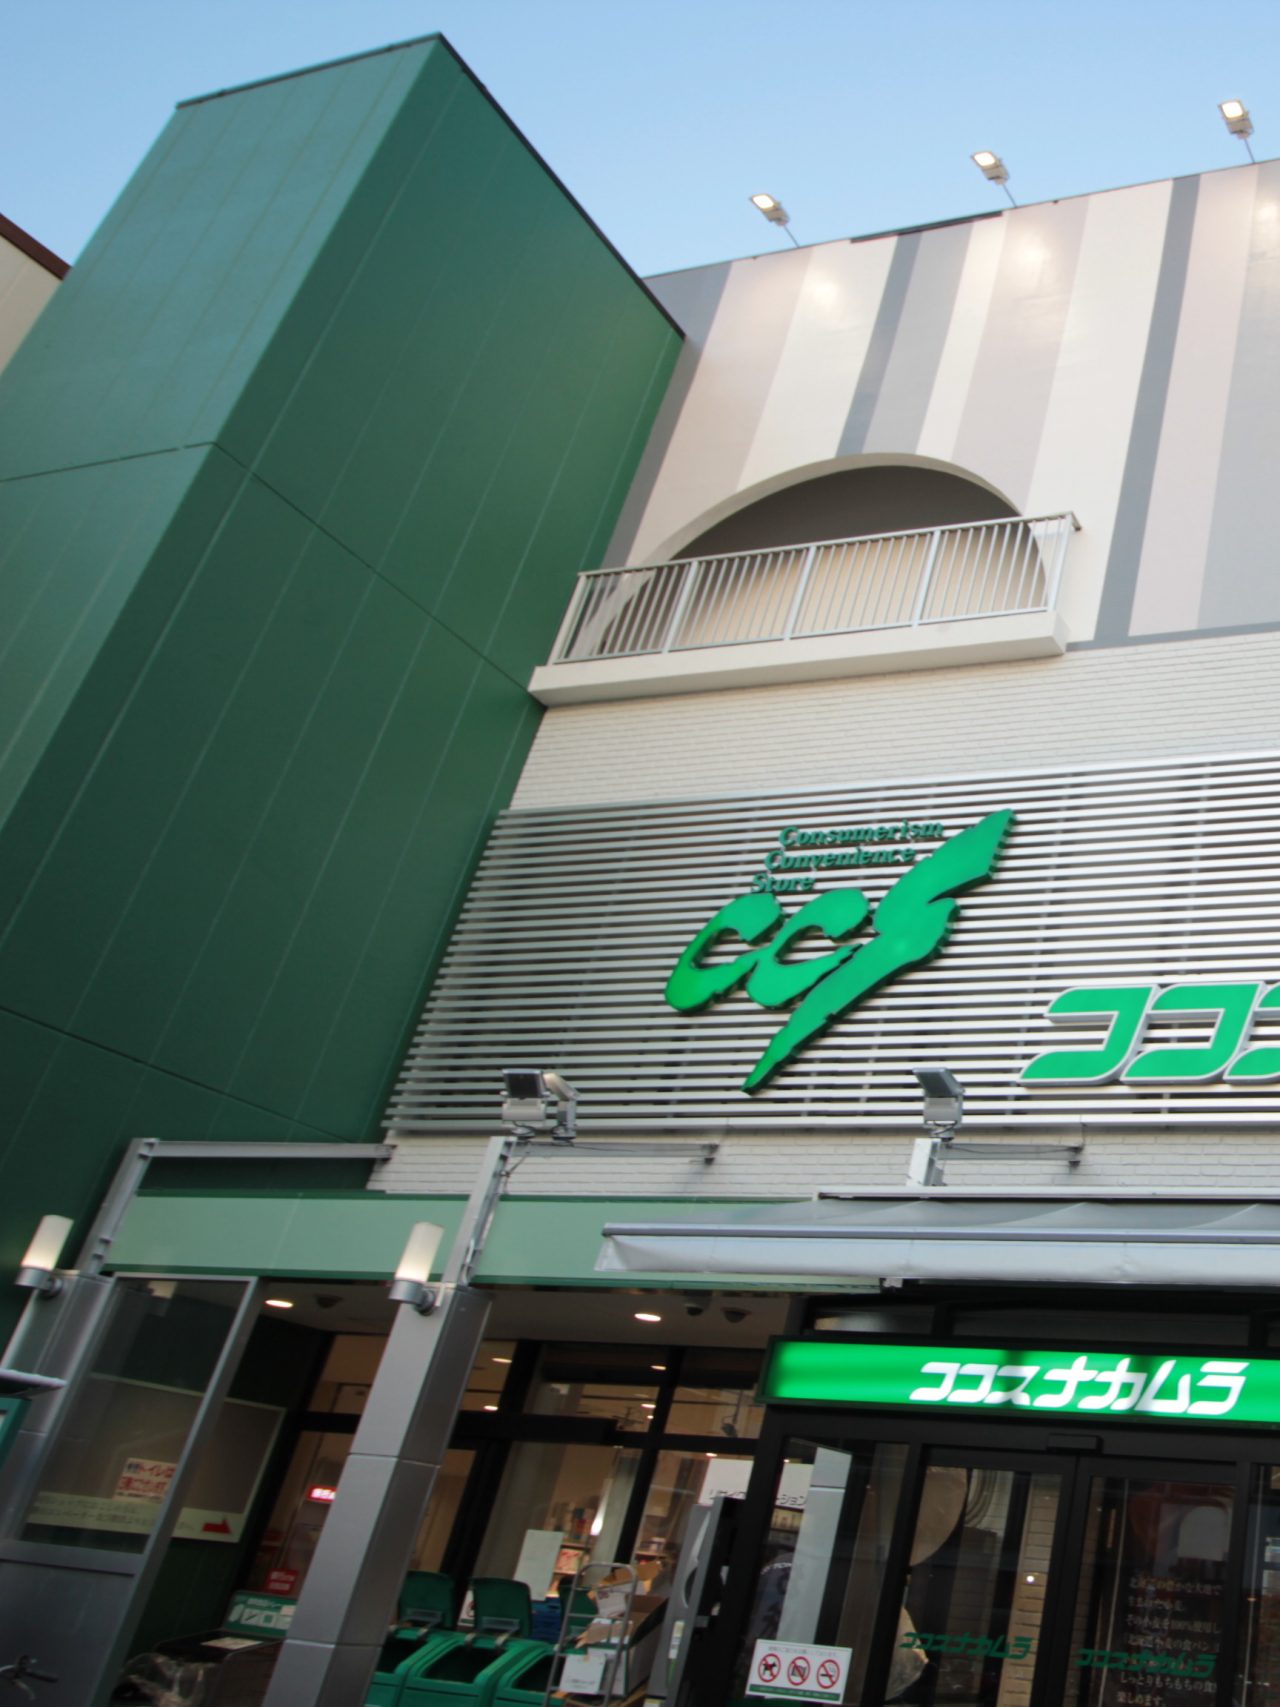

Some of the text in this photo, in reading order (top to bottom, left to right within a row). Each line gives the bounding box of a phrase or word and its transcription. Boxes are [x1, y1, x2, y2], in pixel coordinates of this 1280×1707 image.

[778, 820, 943, 848] Consumerism
[763, 846, 917, 871] Convenience
[751, 873, 816, 895] Store
[909, 1355, 1250, 1415] ココスナカムラ
[899, 1632, 1034, 1660] ココスナカムラ
[1073, 1648, 1218, 1680] ココスナカムラ
